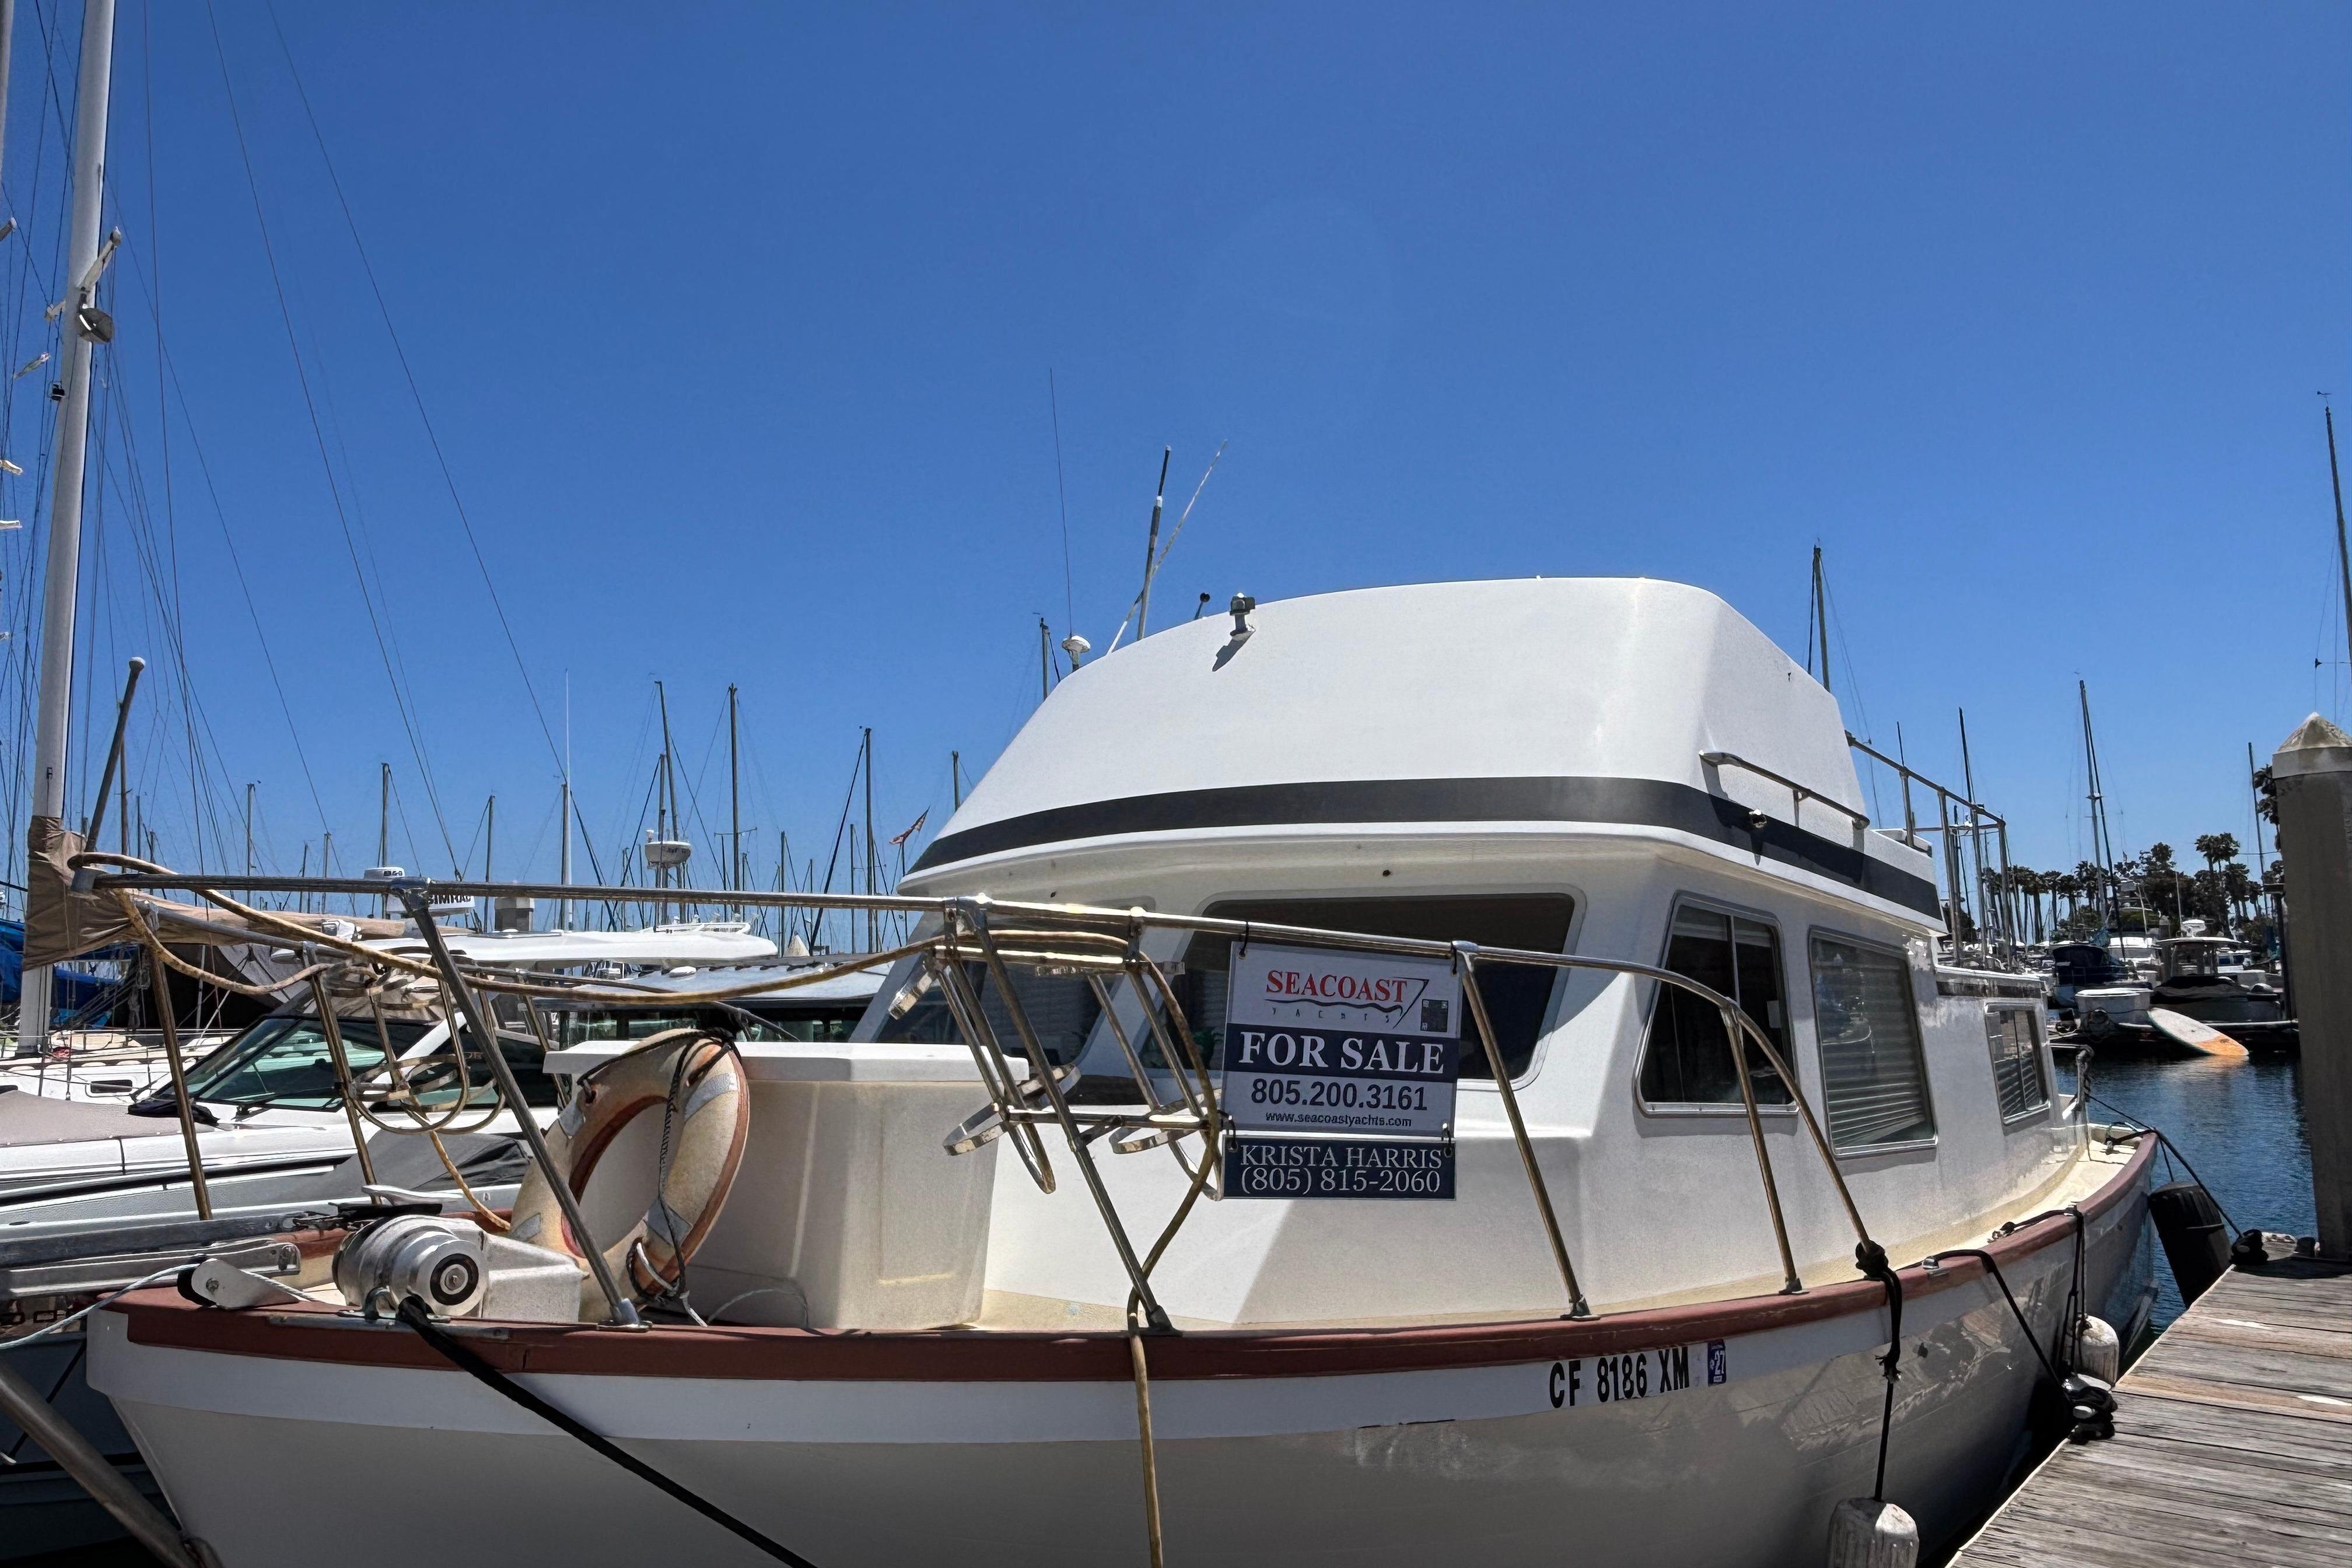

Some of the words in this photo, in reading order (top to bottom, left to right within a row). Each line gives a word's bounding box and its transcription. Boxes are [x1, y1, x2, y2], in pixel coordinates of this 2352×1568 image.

[1266, 970, 1408, 1002] SEACOAST
[1238, 1031, 1329, 1069] FOR
[1340, 1037, 1444, 1074] SALE
[1251, 1078, 1428, 1111] 805.200.3161
[1266, 1112, 1412, 1127] www.seacoastyachts.com
[1240, 1144, 1339, 1167] KRISTA
[1345, 1147, 1443, 1169] HARRIS
[1241, 1166, 1312, 1195] (805)
[1320, 1168, 1441, 1192] 815-2060
[1549, 1360, 1581, 1408] CF
[1597, 1353, 1648, 1403] 8186
[1658, 1346, 1690, 1394] XM
